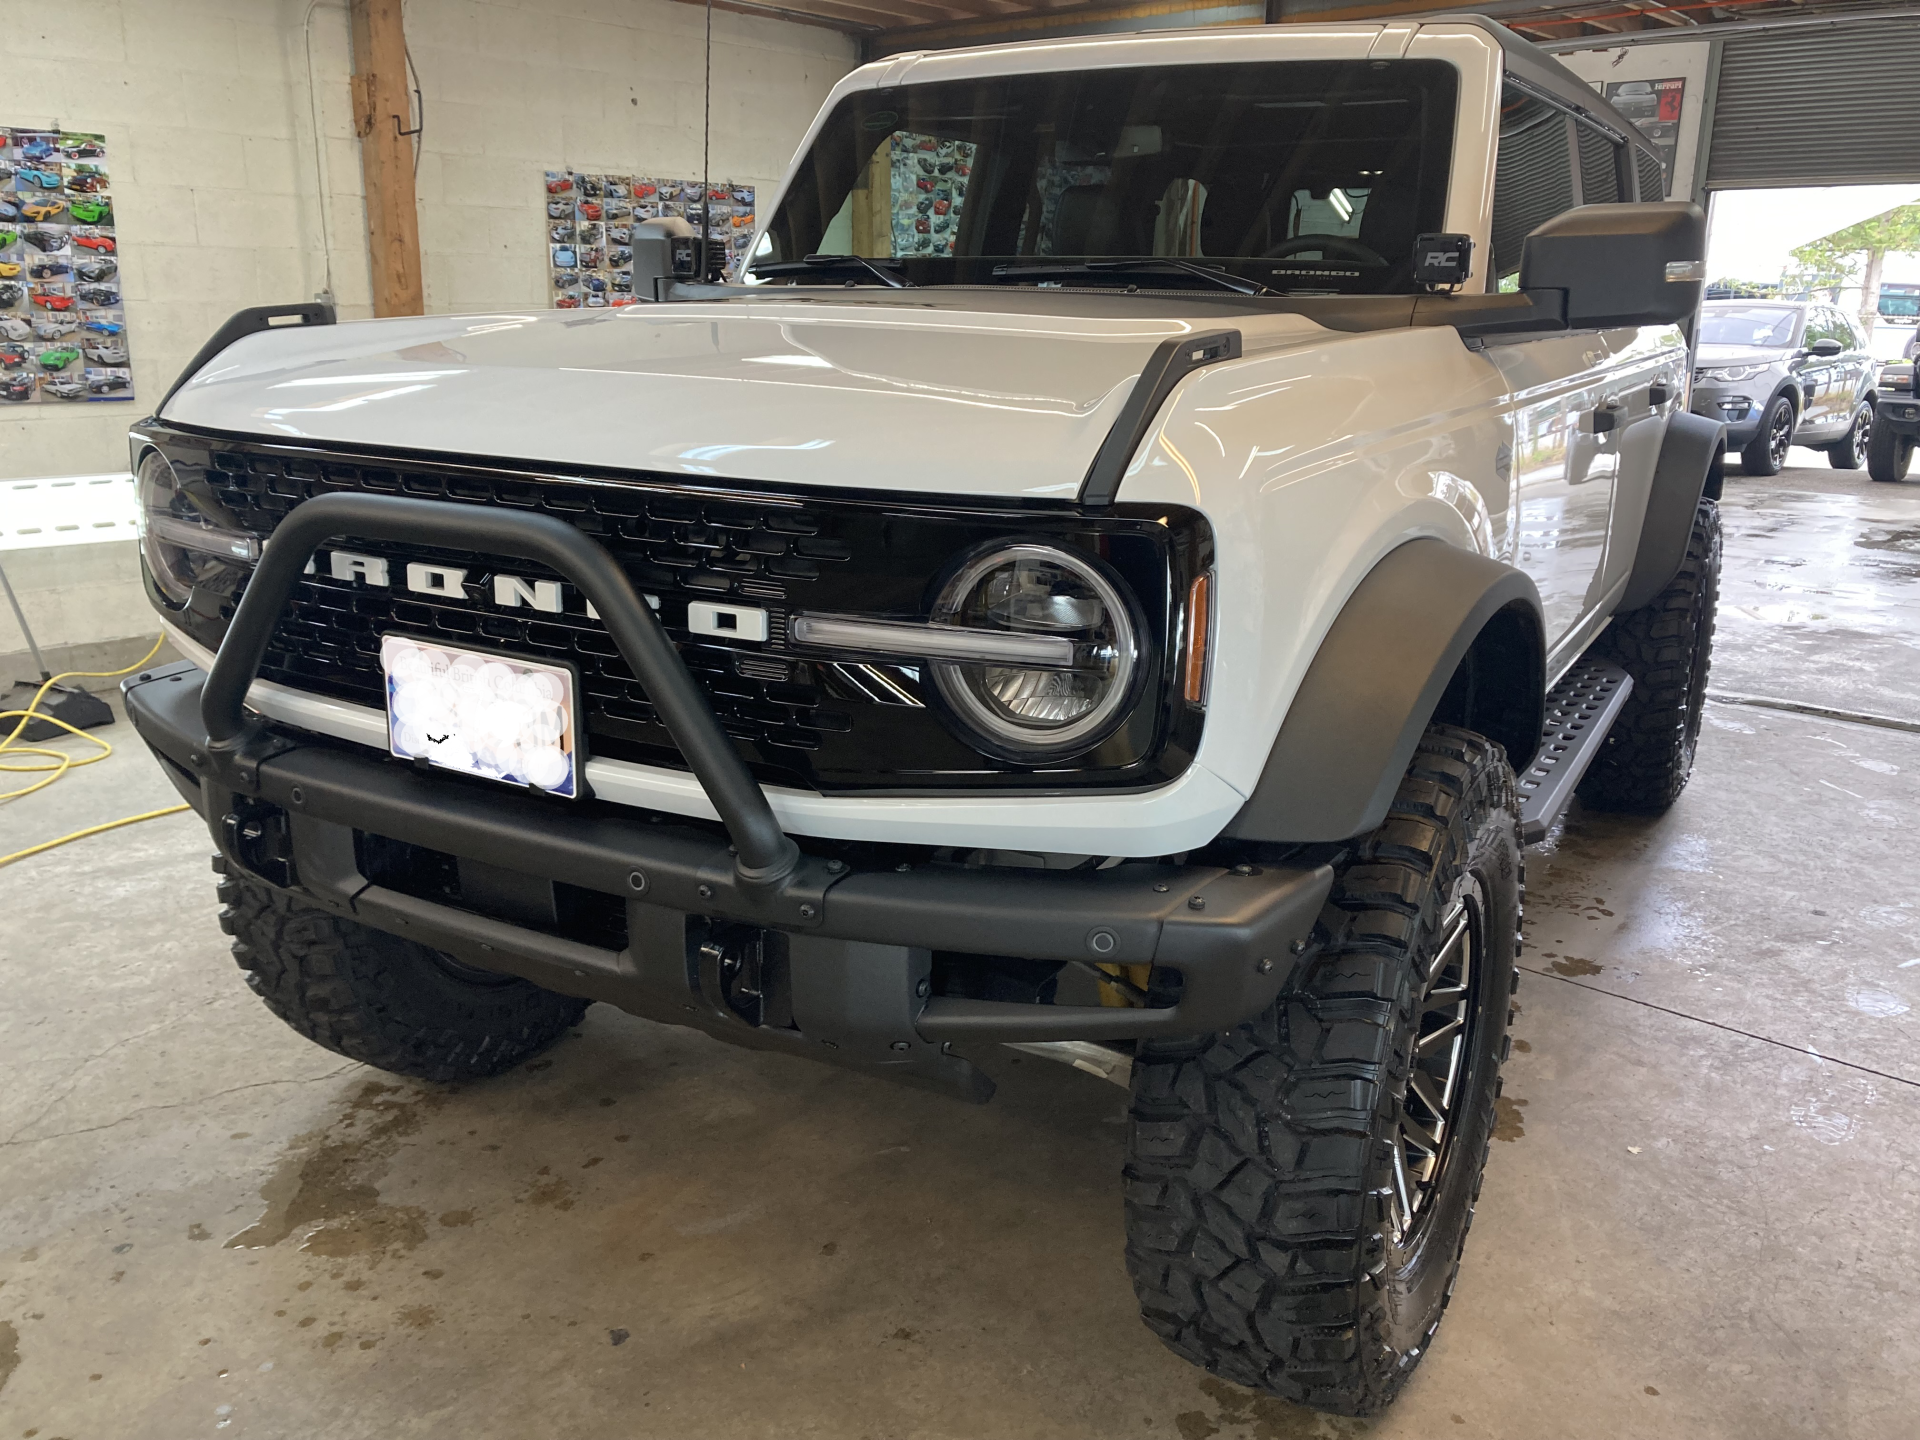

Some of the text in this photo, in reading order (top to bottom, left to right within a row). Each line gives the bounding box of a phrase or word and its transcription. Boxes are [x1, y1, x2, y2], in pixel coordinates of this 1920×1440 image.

[1654, 81, 1682, 90] Ferrari
[676, 250, 692, 260] RC
[1424, 252, 1459, 266] RC
[304, 550, 768, 641] RONO
[399, 655, 552, 700] Beautiful British Columbia
[404, 732, 437, 747] Discov
[519, 758, 561, 777] BC Parks
